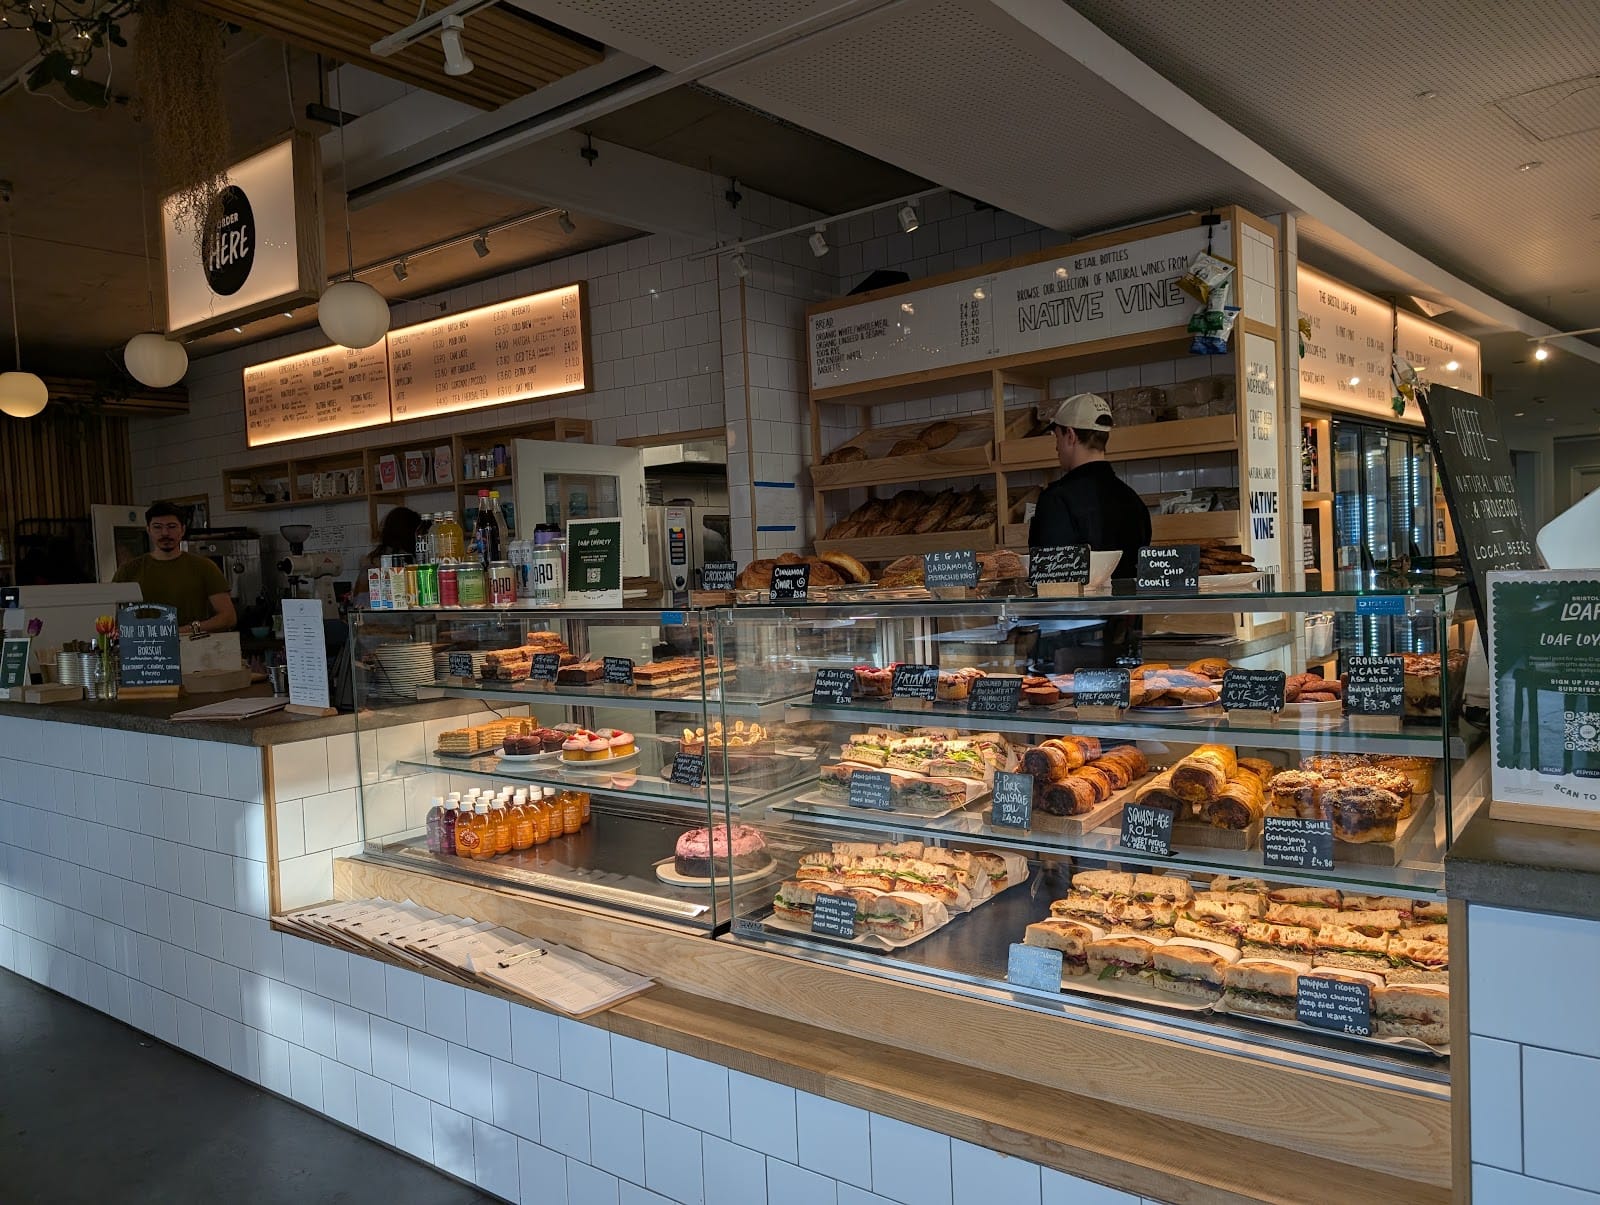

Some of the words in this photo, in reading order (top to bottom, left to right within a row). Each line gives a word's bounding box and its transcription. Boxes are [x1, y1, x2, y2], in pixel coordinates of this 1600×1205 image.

[209, 224, 249, 271] HERE
[1075, 252, 1096, 270] RETAIL
[1100, 249, 1129, 265] BOTTLES
[1017, 286, 1040, 301] BROWSE
[1043, 283, 1055, 295] OUR
[1056, 275, 1089, 293] SELECTION
[1094, 273, 1101, 286] OF
[1105, 266, 1138, 283] NATURAL
[1141, 260, 1165, 276] WINES
[1168, 255, 1188, 272] FROM
[1018, 291, 1104, 332] NATIVE
[1115, 276, 1185, 314] VINE
[1451, 406, 1491, 462] COFFEE
[1455, 475, 1493, 493] NATURAL
[1494, 475, 1515, 493] WINES
[1249, 491, 1278, 514] NATIVE
[1480, 498, 1518, 518] PROSECCO
[1253, 518, 1274, 540] VINE
[925, 551, 970, 562] VEGAN
[1140, 549, 1179, 558] REGULAR
[1474, 545, 1506, 560] LOCAL
[1507, 541, 1532, 555] BEERS
[1149, 560, 1170, 568] CHOC
[704, 570, 736, 582] CROISSANT
[1163, 567, 1184, 575] CHIP
[1138, 576, 1171, 587] COOKIE
[119, 624, 134, 638] SOUP
[147, 624, 158, 638] THE
[160, 624, 176, 638] DAY!
[1540, 633, 1573, 646] LOAF
[1576, 633, 1600, 646] LOY
[1349, 656, 1403, 666] CROISSANT
[1358, 666, 1389, 675] CAKE
[897, 671, 931, 684] FRIAND
[1227, 690, 1252, 701] RYE
[1363, 697, 1390, 711] £3.70
[1003, 774, 1022, 793] PORK
[993, 791, 1028, 805] SAUSAGE
[1553, 783, 1579, 799] SCAN
[1584, 793, 1597, 801] TO
[1002, 803, 1020, 814] ROLL
[1127, 806, 1169, 829] SQUASH-AGE
[1266, 817, 1302, 828] SAVOURY
[1304, 820, 1331, 830] SWIRL
[1129, 824, 1159, 837] ROLL
[1266, 852, 1279, 860] hot
[1281, 853, 1304, 865] honey
[1299, 978, 1329, 990] Whipped
[1298, 989, 1328, 999] tomato
[1299, 997, 1316, 1009] deep
[1317, 1001, 1335, 1009] fried
[1299, 1008, 1323, 1018] mixed
[1326, 1012, 1353, 1022] leaves
[1343, 1023, 1369, 1035] £6.50
